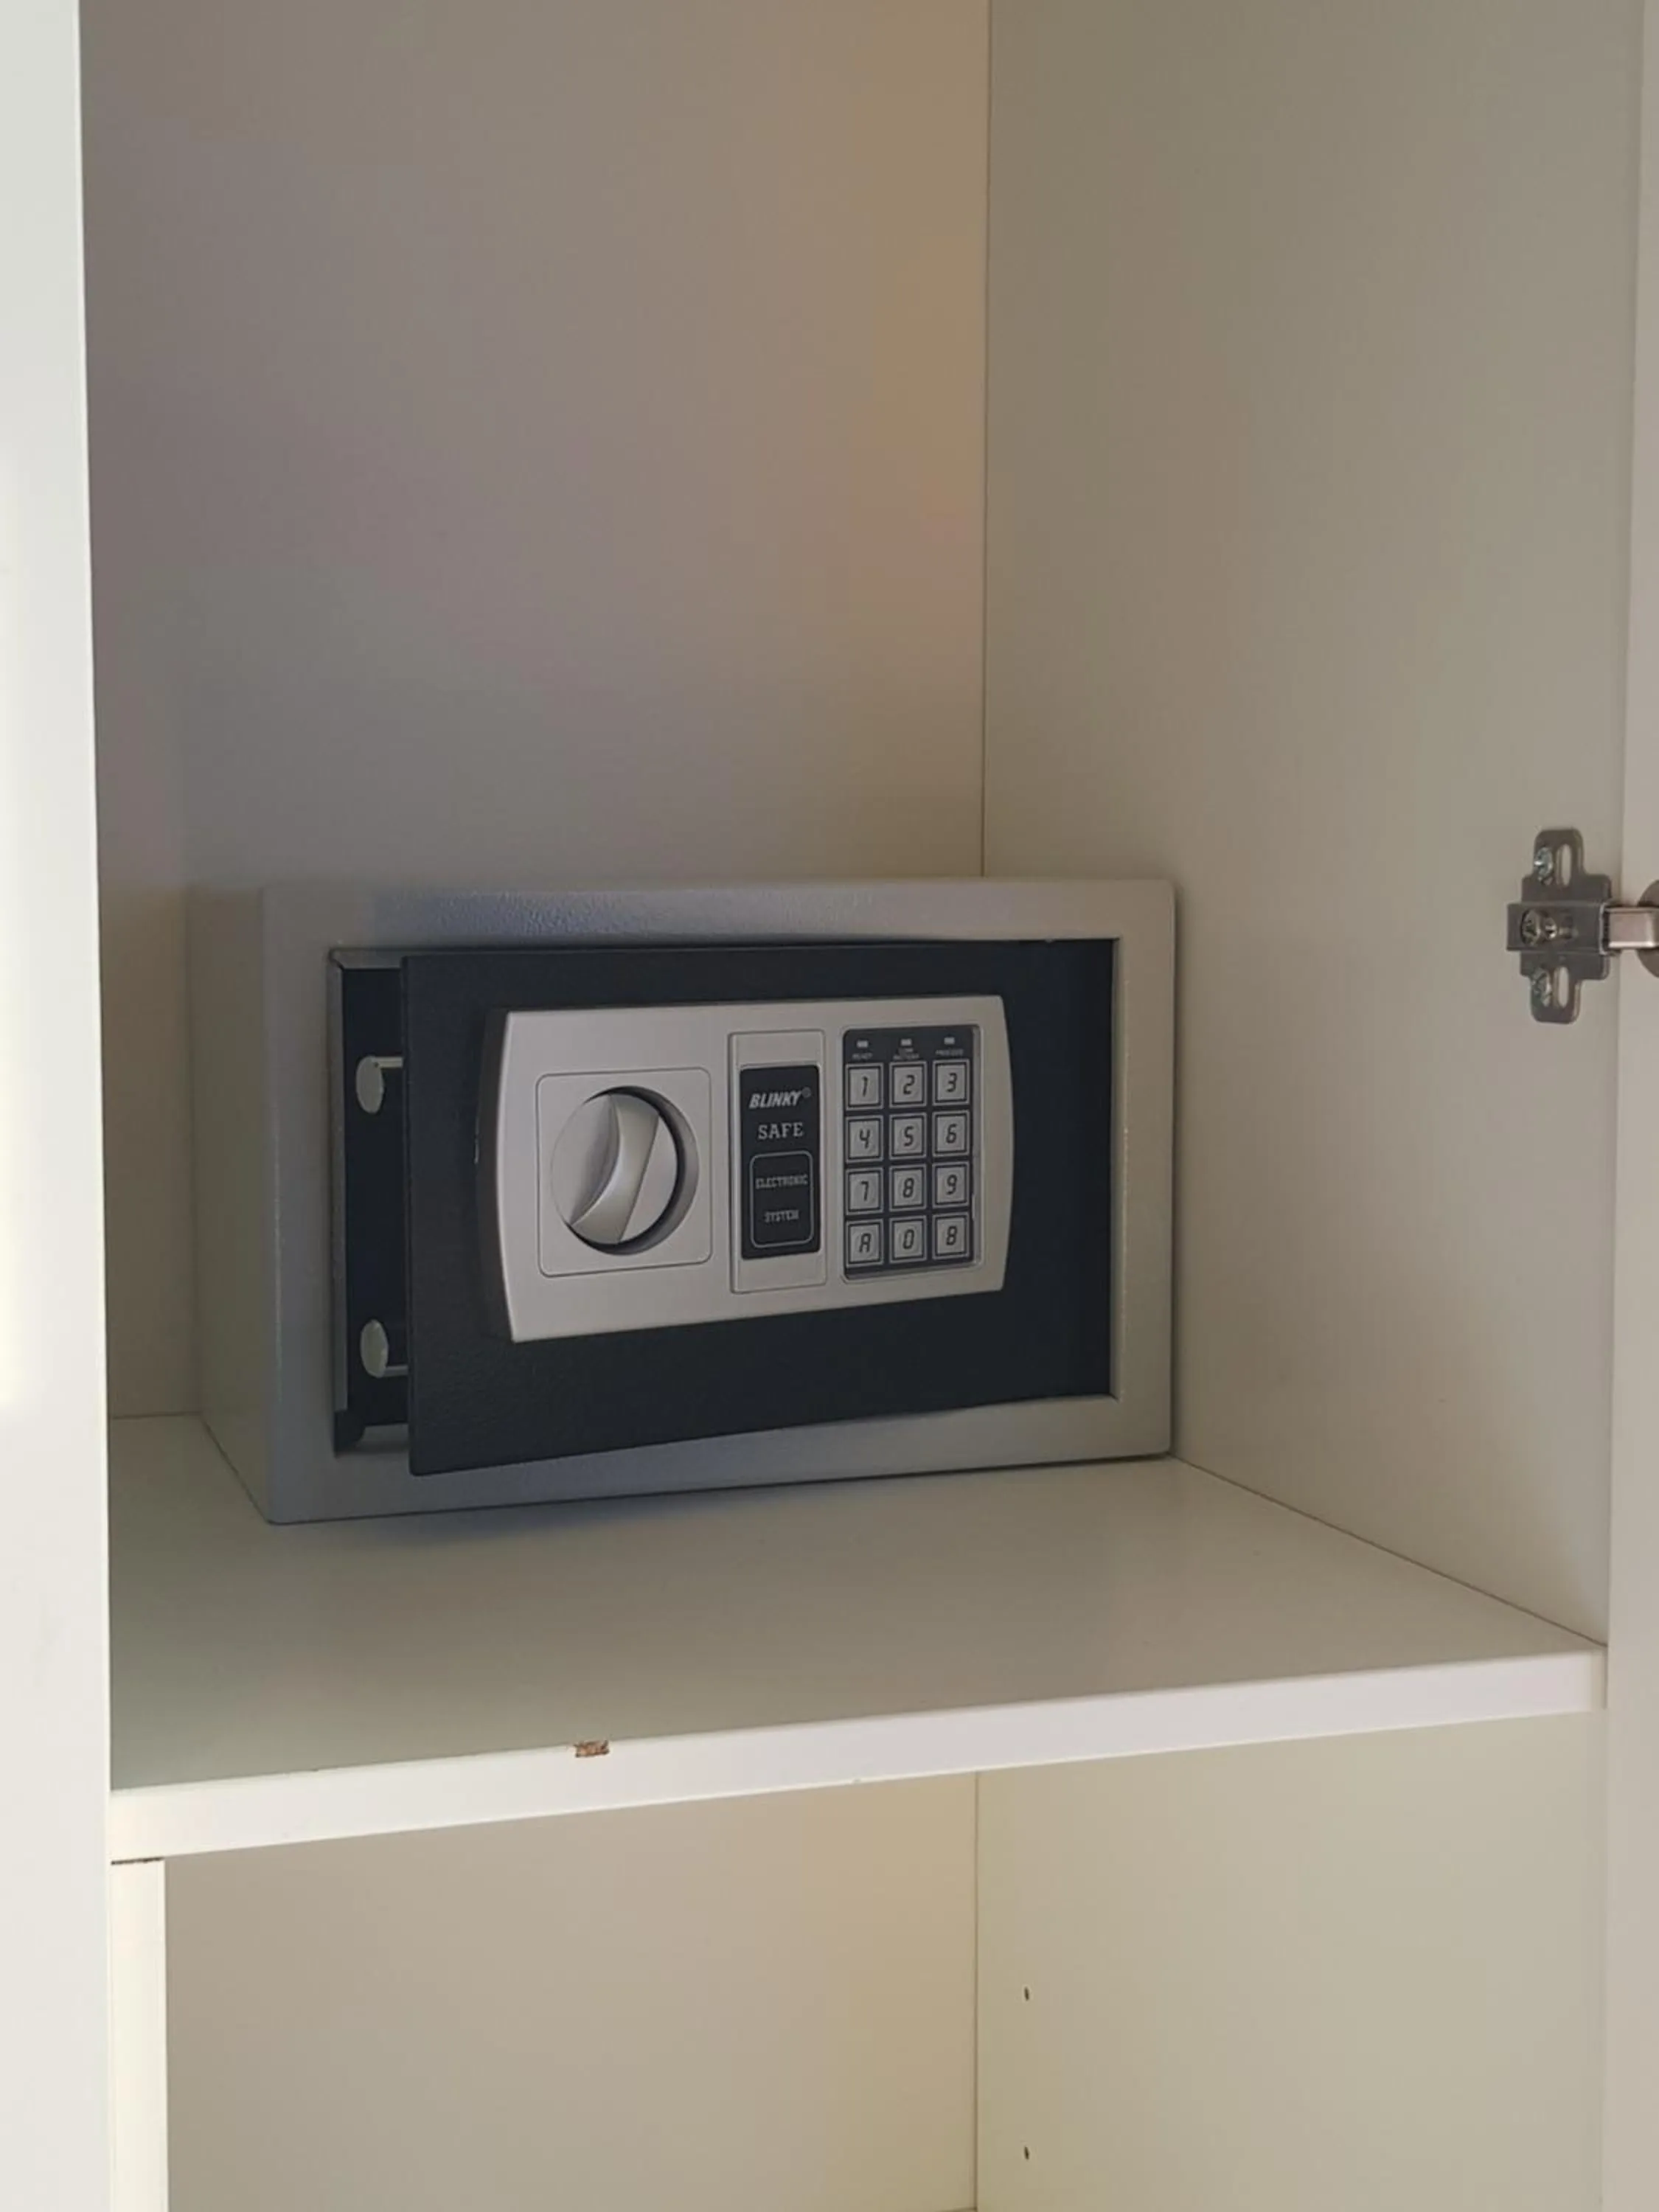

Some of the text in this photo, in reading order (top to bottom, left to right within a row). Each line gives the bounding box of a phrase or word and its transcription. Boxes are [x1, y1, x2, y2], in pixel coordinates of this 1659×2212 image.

[862, 1072, 958, 1097] 1 2 3
[748, 1091, 802, 1109] BLINKY
[757, 1121, 803, 1140] SAFE
[859, 1123, 958, 1150] 4 5 6
[860, 1174, 958, 1201] 7 8 9
[859, 1233, 872, 1253] A
[902, 1228, 915, 1250] 0
